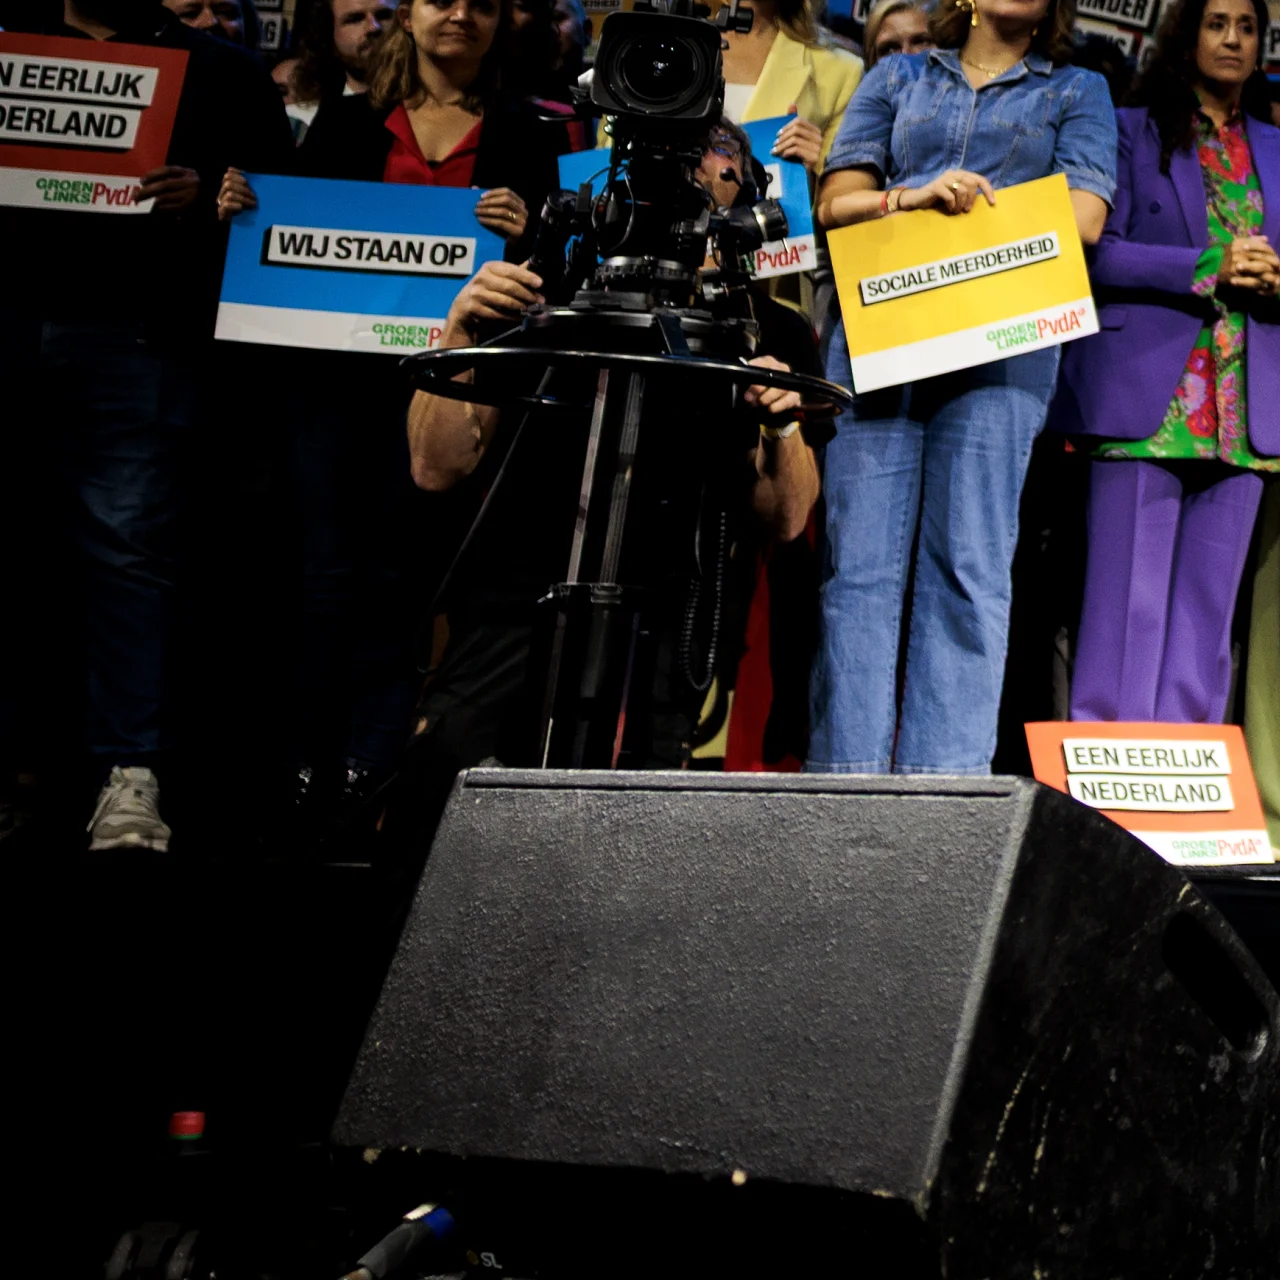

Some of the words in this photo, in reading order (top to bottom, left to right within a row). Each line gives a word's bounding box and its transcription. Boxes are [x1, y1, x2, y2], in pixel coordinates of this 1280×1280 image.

[19, 63, 144, 99] EERLIJK
[36, 178, 93, 195] GROEN
[43, 189, 91, 205] LINKS
[278, 231, 330, 258] WIJ
[333, 236, 425, 265] STAAN
[429, 242, 468, 267] OP
[755, 245, 801, 271] PvdA
[866, 266, 938, 297] SOCIALE
[939, 236, 1055, 281] MEERDERHEID
[372, 323, 430, 337] GROEN
[985, 320, 1037, 343] GROEN
[1036, 311, 1081, 339] PvdA
[379, 334, 427, 348] LINKS
[995, 331, 1039, 351] LINKS
[1073, 746, 1120, 767] EEN
[1126, 748, 1220, 769] EERLIJK
[1080, 781, 1222, 803] NEDERLAND
